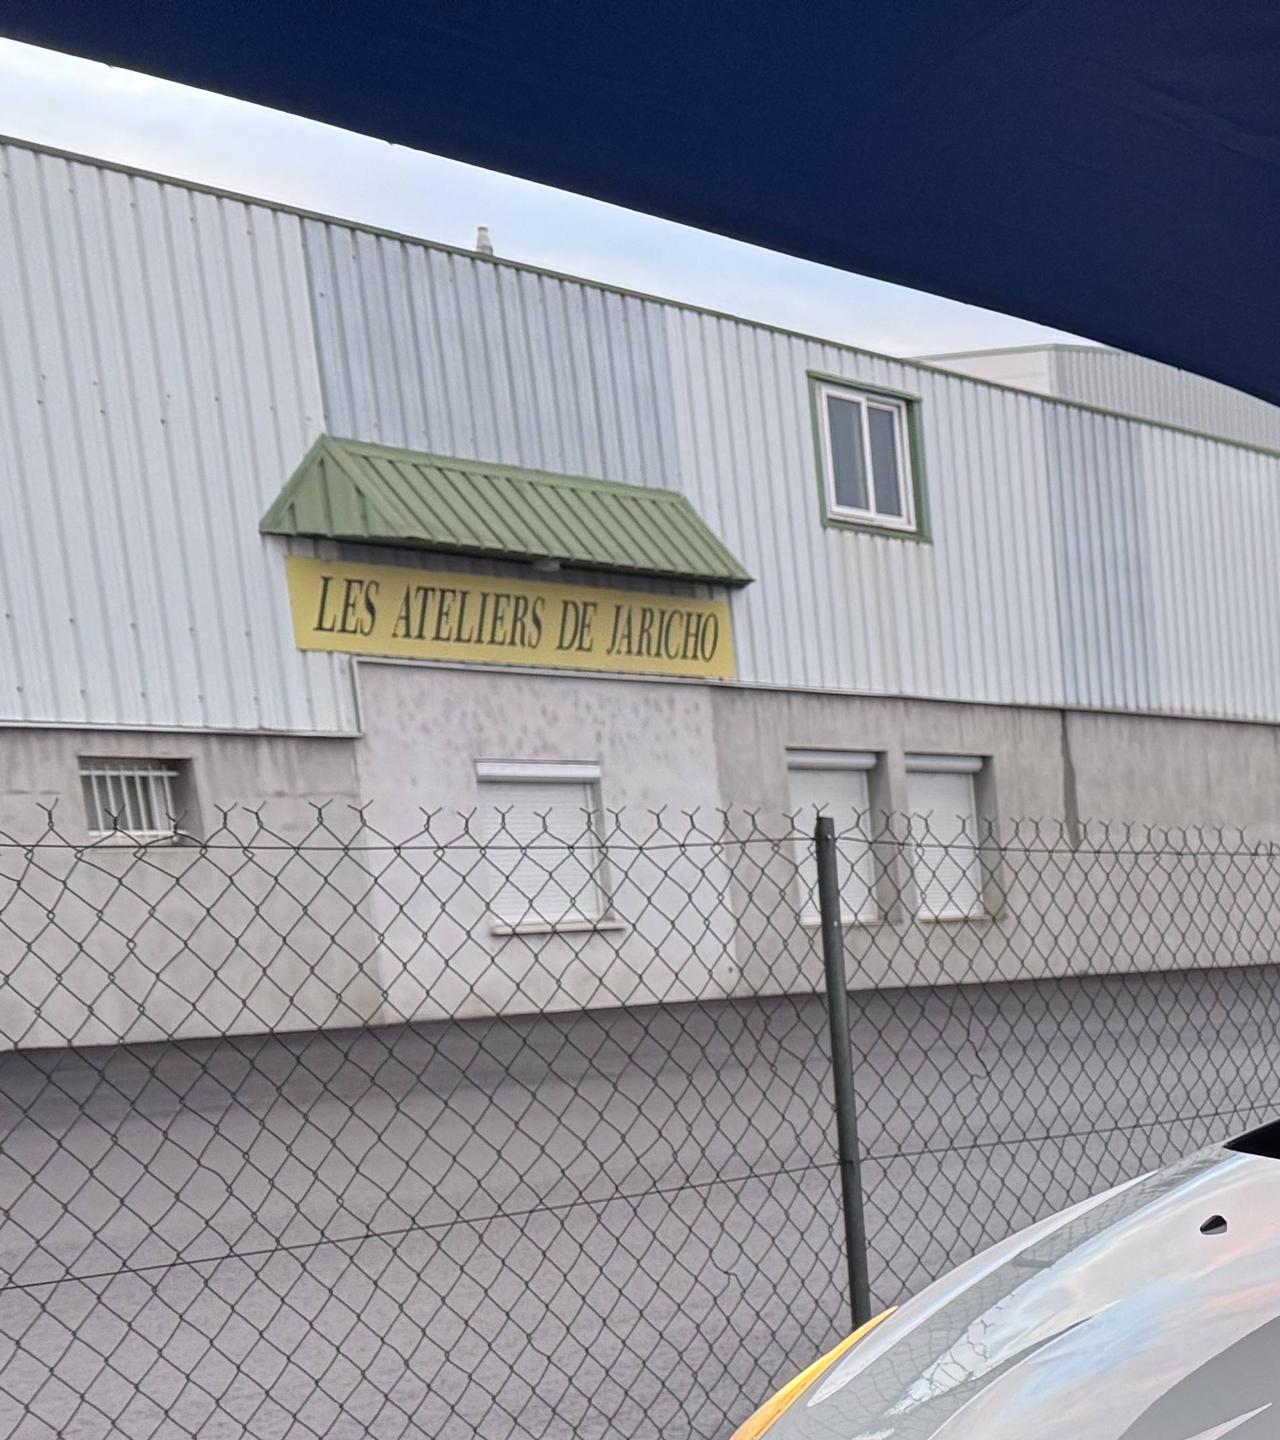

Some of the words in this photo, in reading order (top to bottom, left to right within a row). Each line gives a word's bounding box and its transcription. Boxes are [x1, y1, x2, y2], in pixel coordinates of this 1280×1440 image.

[313, 576, 380, 637] LES
[391, 583, 544, 650] ATELIERS
[555, 599, 597, 653] DE
[606, 604, 720, 663] JARICHO
